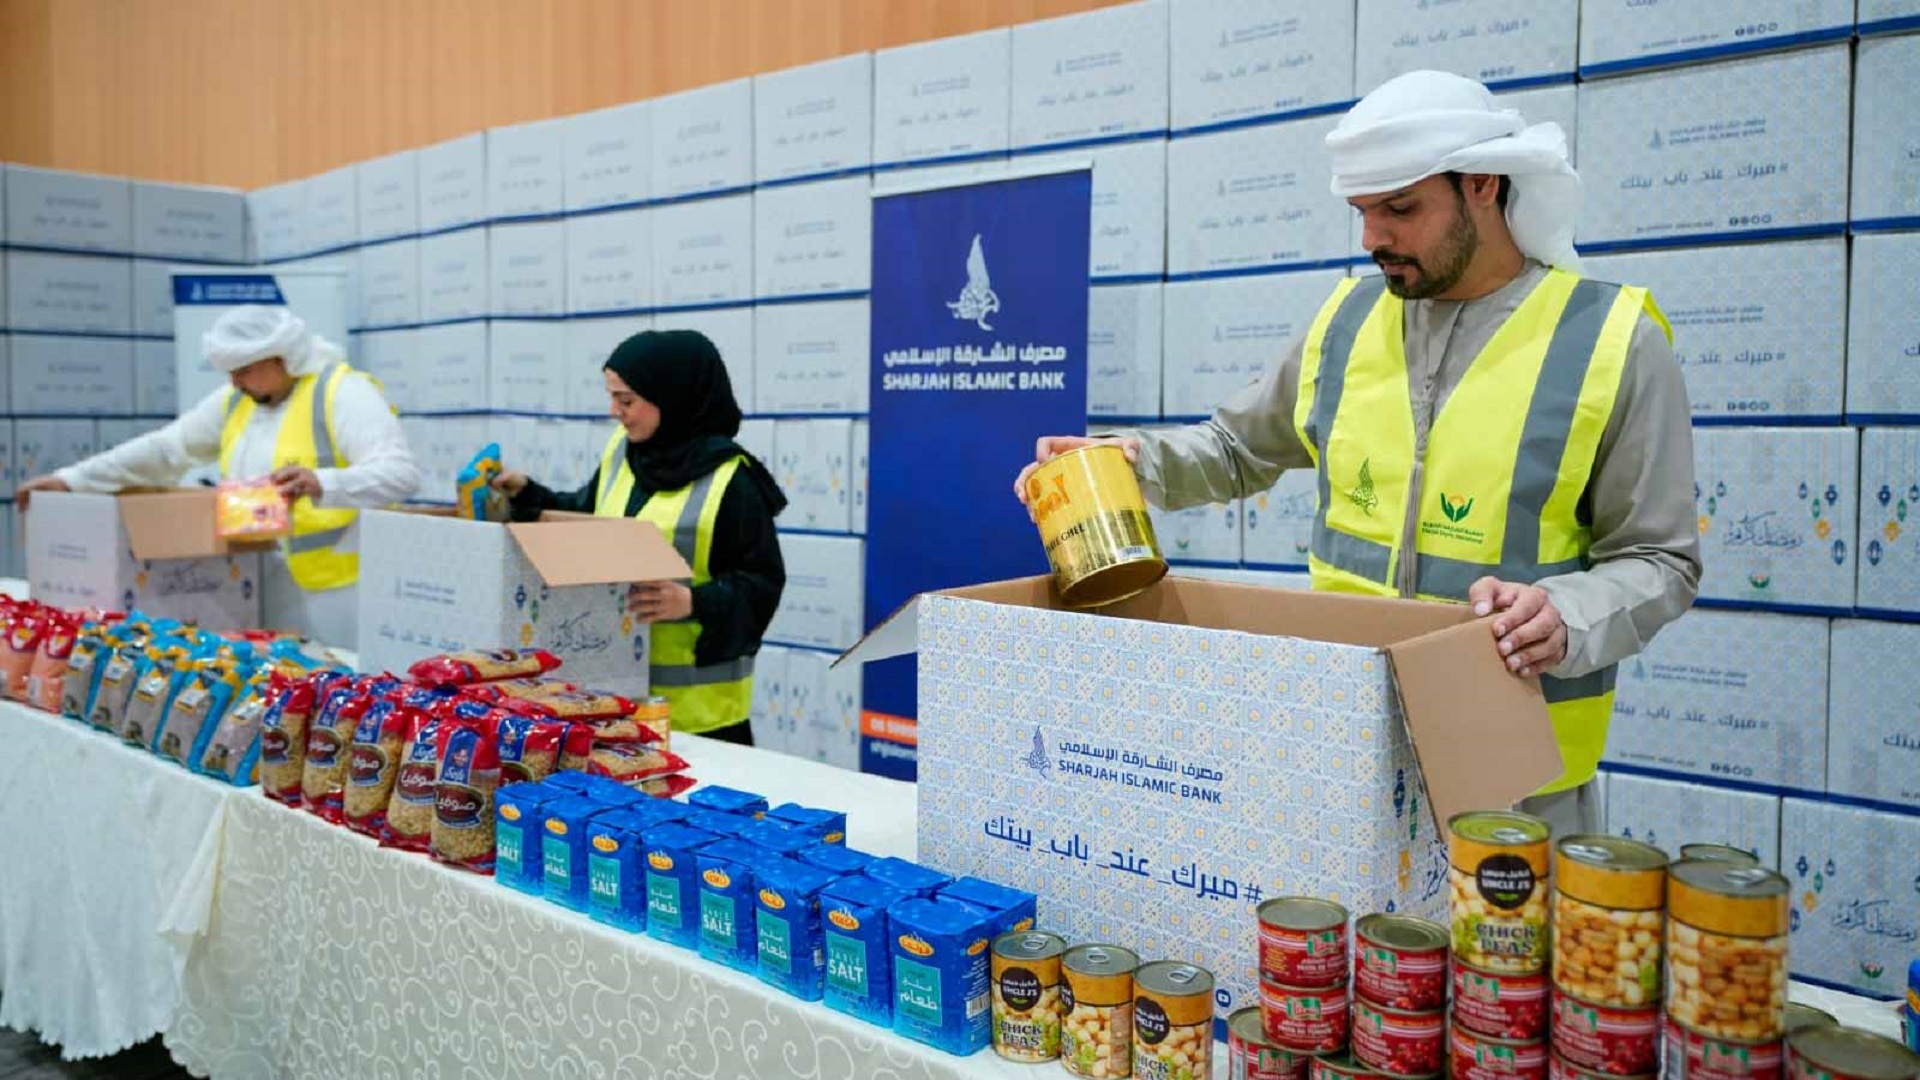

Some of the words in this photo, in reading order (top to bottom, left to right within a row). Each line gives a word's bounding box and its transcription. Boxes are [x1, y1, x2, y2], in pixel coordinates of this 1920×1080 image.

[953, 341, 1016, 366] الشارقة
[1019, 341, 1067, 365] مصرف
[882, 373, 949, 391] SHARJAH
[952, 372, 1016, 390] ISLAMIC
[1018, 371, 1066, 389] BANK
[1122, 750, 1177, 774] الشارقة
[1181, 763, 1224, 782] مصرف
[1059, 759, 1118, 783] SHARJAH
[1121, 771, 1176, 796] ISLAMIC
[1180, 783, 1223, 805] BANK
[591, 876, 618, 897] SALT
[702, 913, 732, 937] SALT
[1476, 922, 1536, 939] CHICK
[1481, 937, 1534, 955] PEAS
[829, 958, 864, 984] SALT
[1001, 1020, 1043, 1035] CHICK
[1003, 1032, 1040, 1047] PEAS
